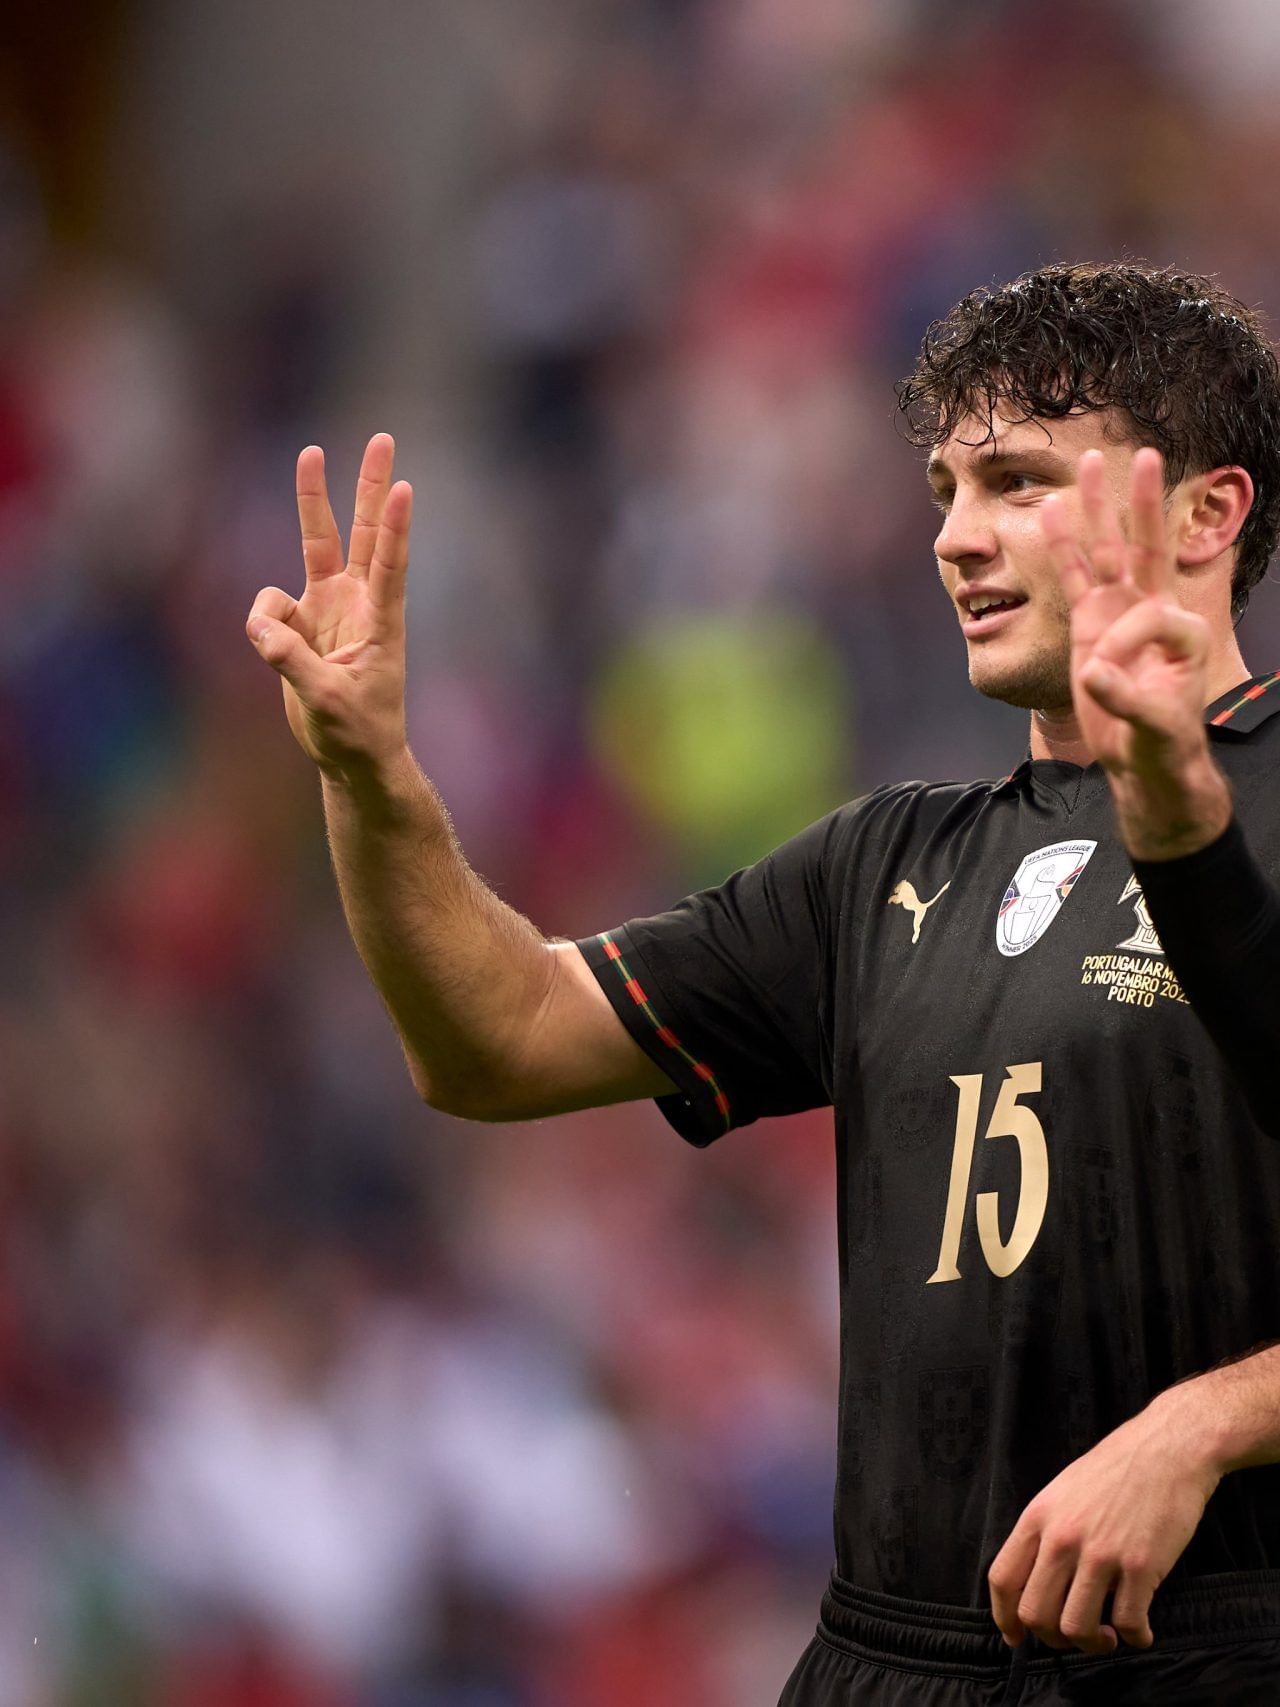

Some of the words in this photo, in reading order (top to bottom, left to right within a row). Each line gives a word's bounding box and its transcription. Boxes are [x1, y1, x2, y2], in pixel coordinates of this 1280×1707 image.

[1041, 846, 1068, 857] NATIONS
[1068, 844, 1093, 852] LEAGUE
[1081, 970, 1092, 984] 16
[1093, 970, 1160, 993] NOVEMBRO
[1107, 986, 1155, 1008] PORTO
[925, 1061, 1049, 1284] 15
